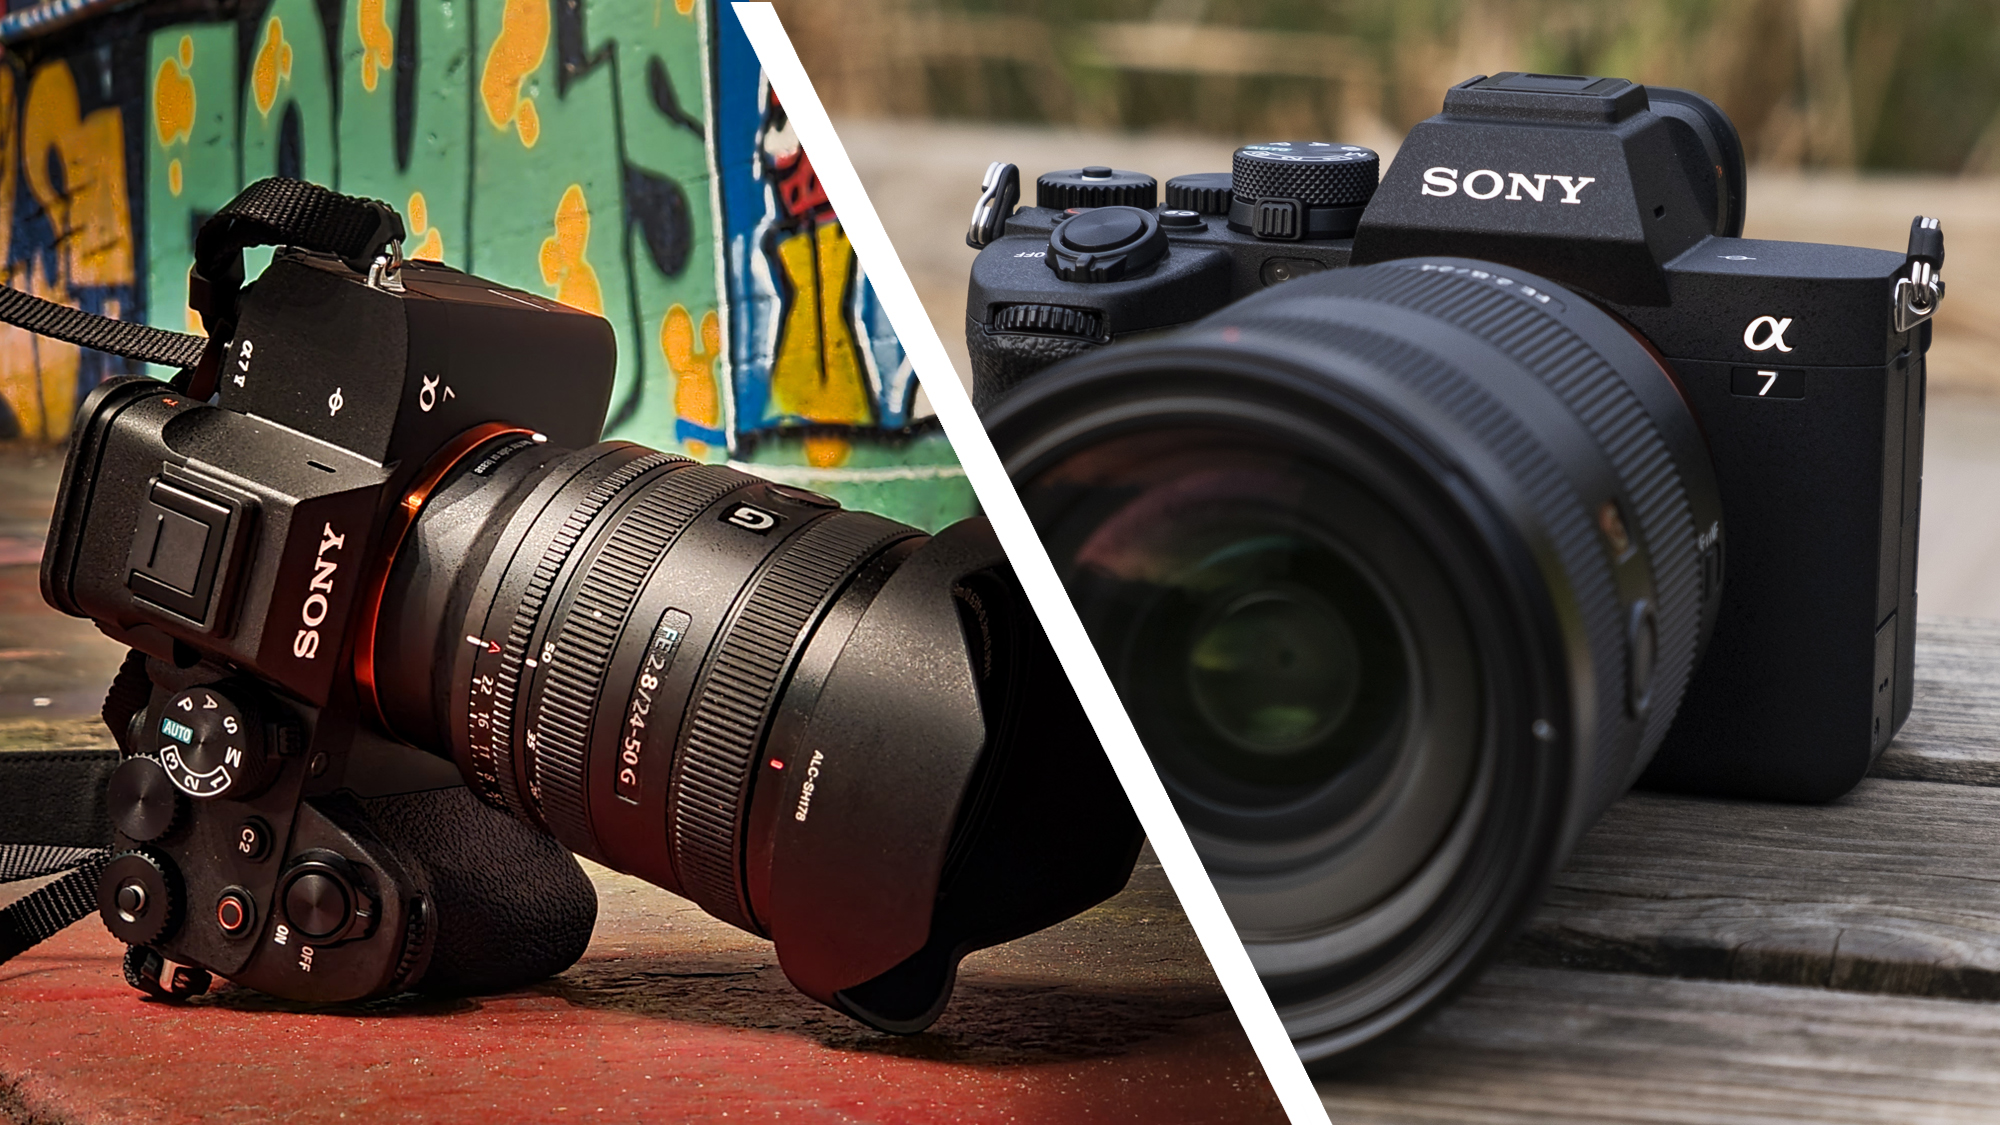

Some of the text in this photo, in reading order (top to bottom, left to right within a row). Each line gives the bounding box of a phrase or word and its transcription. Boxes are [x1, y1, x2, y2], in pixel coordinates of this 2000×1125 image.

[1421, 166, 1595, 204] SONY
[1756, 370, 1780, 397] 7
[728, 507, 775, 530] G
[293, 522, 345, 659] SONY
[541, 641, 556, 663] 50
[480, 674, 494, 696] 22
[177, 696, 193, 712] P
[203, 694, 218, 711] A
[620, 625, 677, 786] FE 2.8/24-50 G
[163, 719, 194, 744] AUTO
[223, 716, 239, 735] S
[477, 711, 490, 730] 16
[526, 728, 536, 751] 35
[165, 751, 179, 770] 3
[225, 746, 242, 768] M
[479, 744, 491, 760] 11
[184, 774, 200, 790] 2
[209, 775, 224, 789] 1
[795, 749, 825, 822] ALC-SH178
[239, 828, 255, 853] C2
[274, 924, 289, 946] ON
[299, 945, 314, 972] OFF
